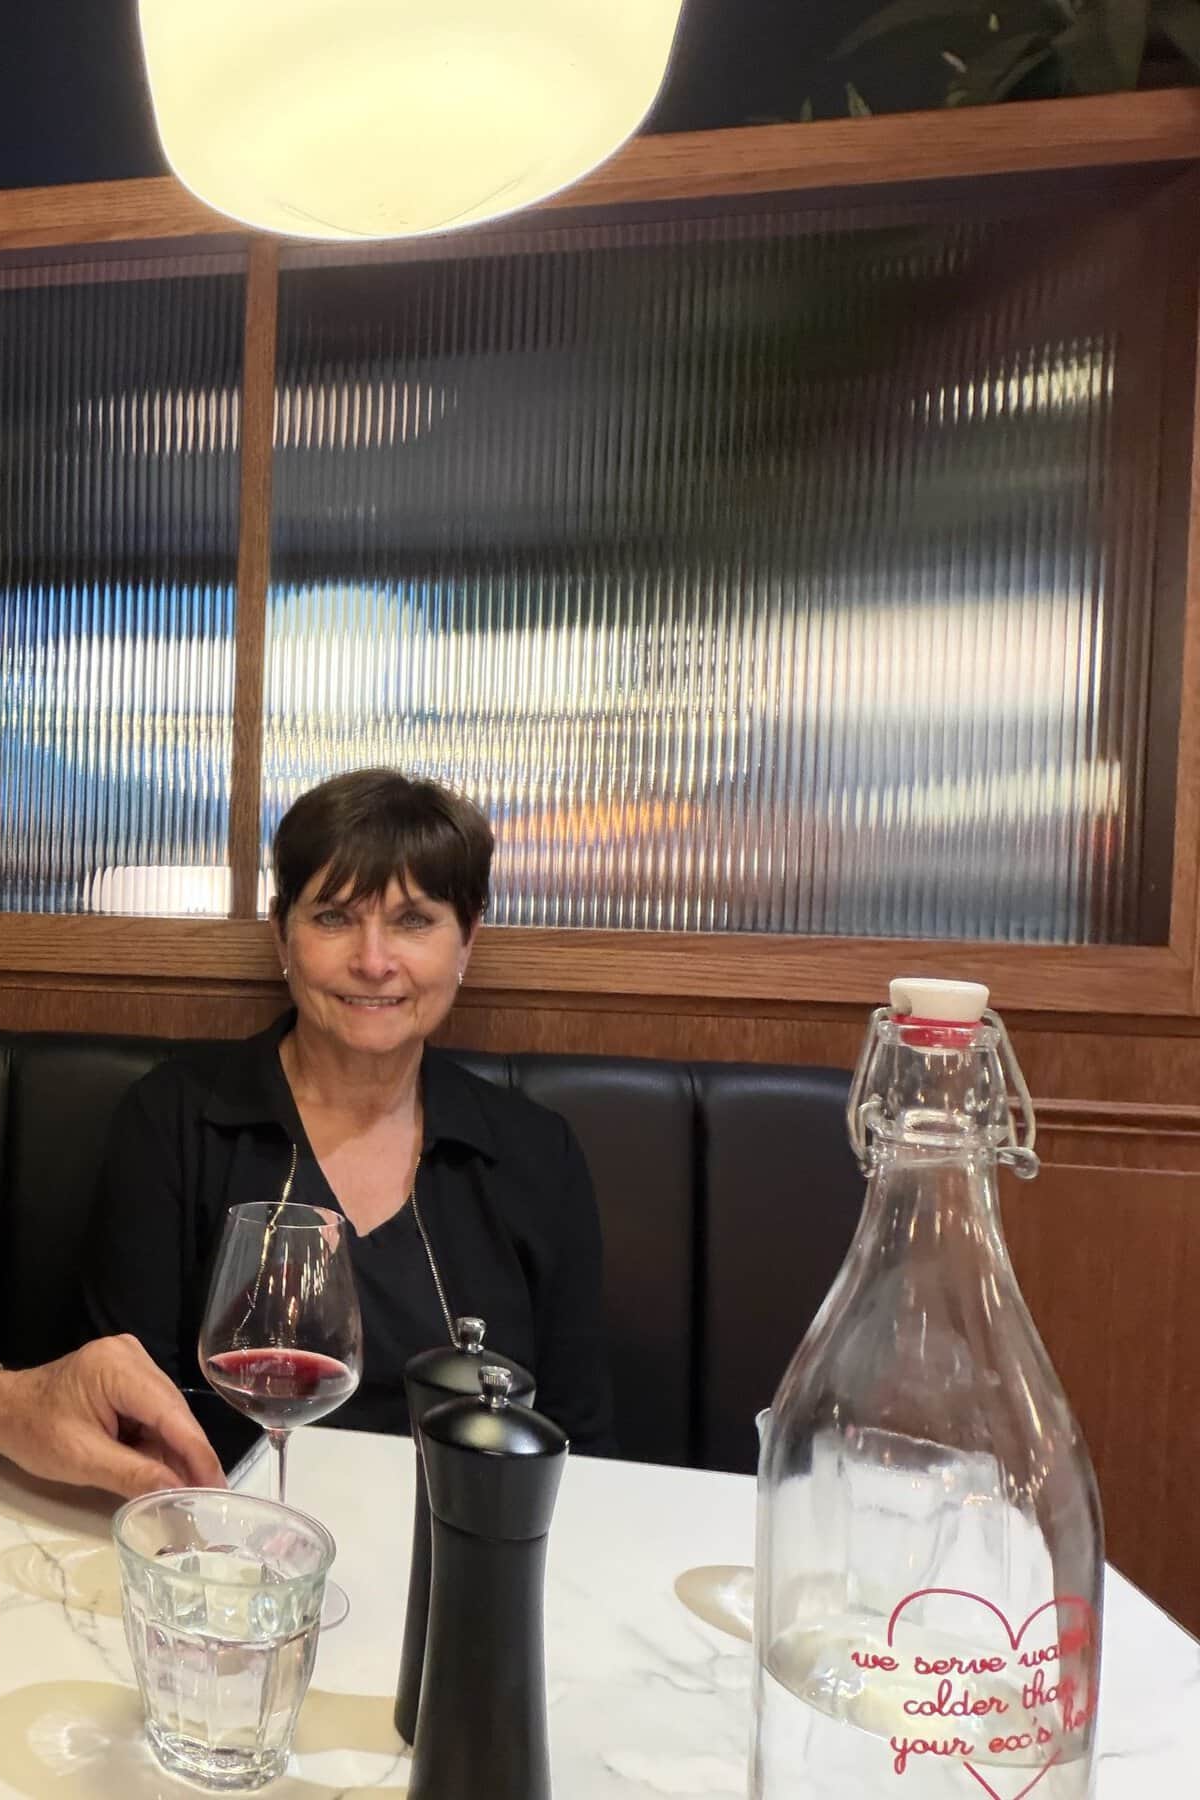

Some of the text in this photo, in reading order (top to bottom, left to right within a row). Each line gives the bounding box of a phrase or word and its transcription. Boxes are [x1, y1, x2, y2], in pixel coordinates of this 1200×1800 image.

[852, 1649, 1006, 1674] we serve
[903, 1679, 1008, 1716] colder
[891, 1735, 974, 1775] your
